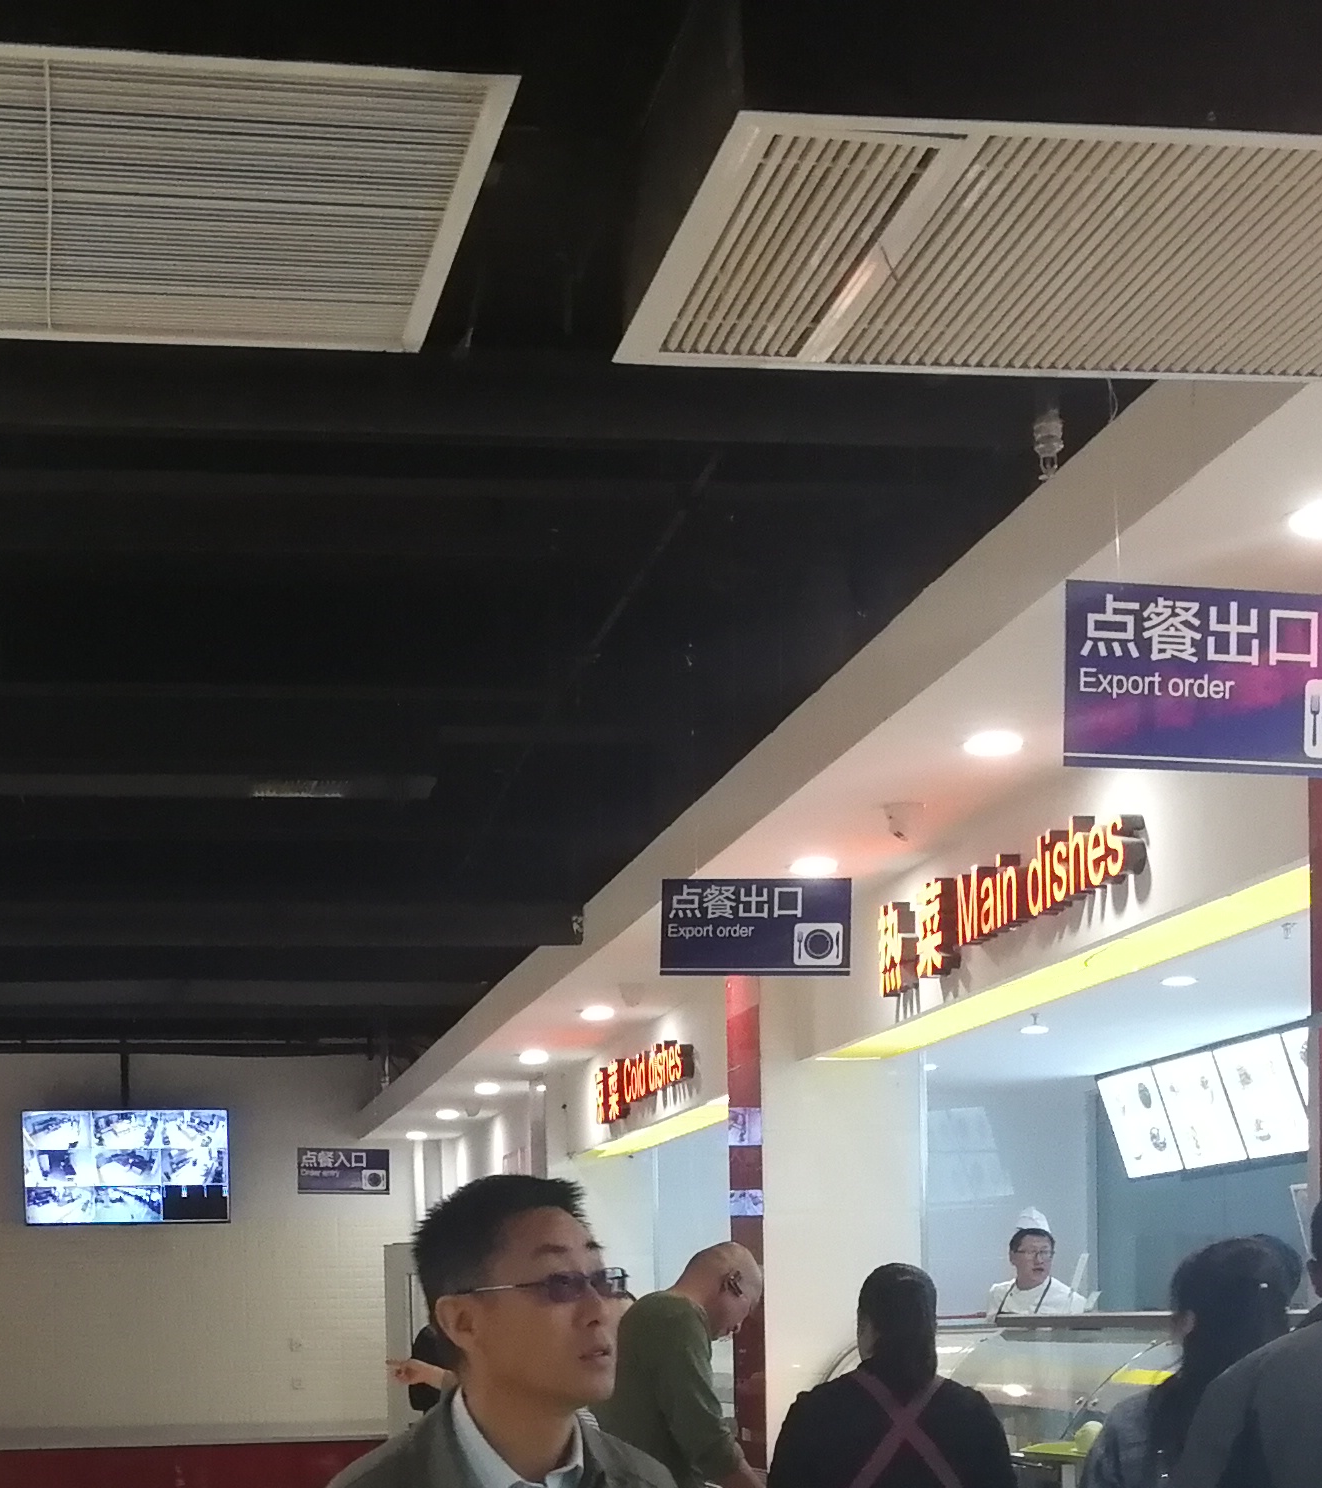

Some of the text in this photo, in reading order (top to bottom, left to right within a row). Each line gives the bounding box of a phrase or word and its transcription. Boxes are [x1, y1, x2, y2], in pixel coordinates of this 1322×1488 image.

[1079, 594, 1319, 668] 点餐出口
[1079, 667, 1235, 700] Export order
[668, 884, 803, 919] 点餐出口
[957, 814, 1125, 946] Main dishes
[667, 923, 755, 939] Export order
[878, 879, 943, 997] 热菜
[623, 1043, 682, 1103] Cold dishes
[300, 1150, 367, 1168] 点餐入口
